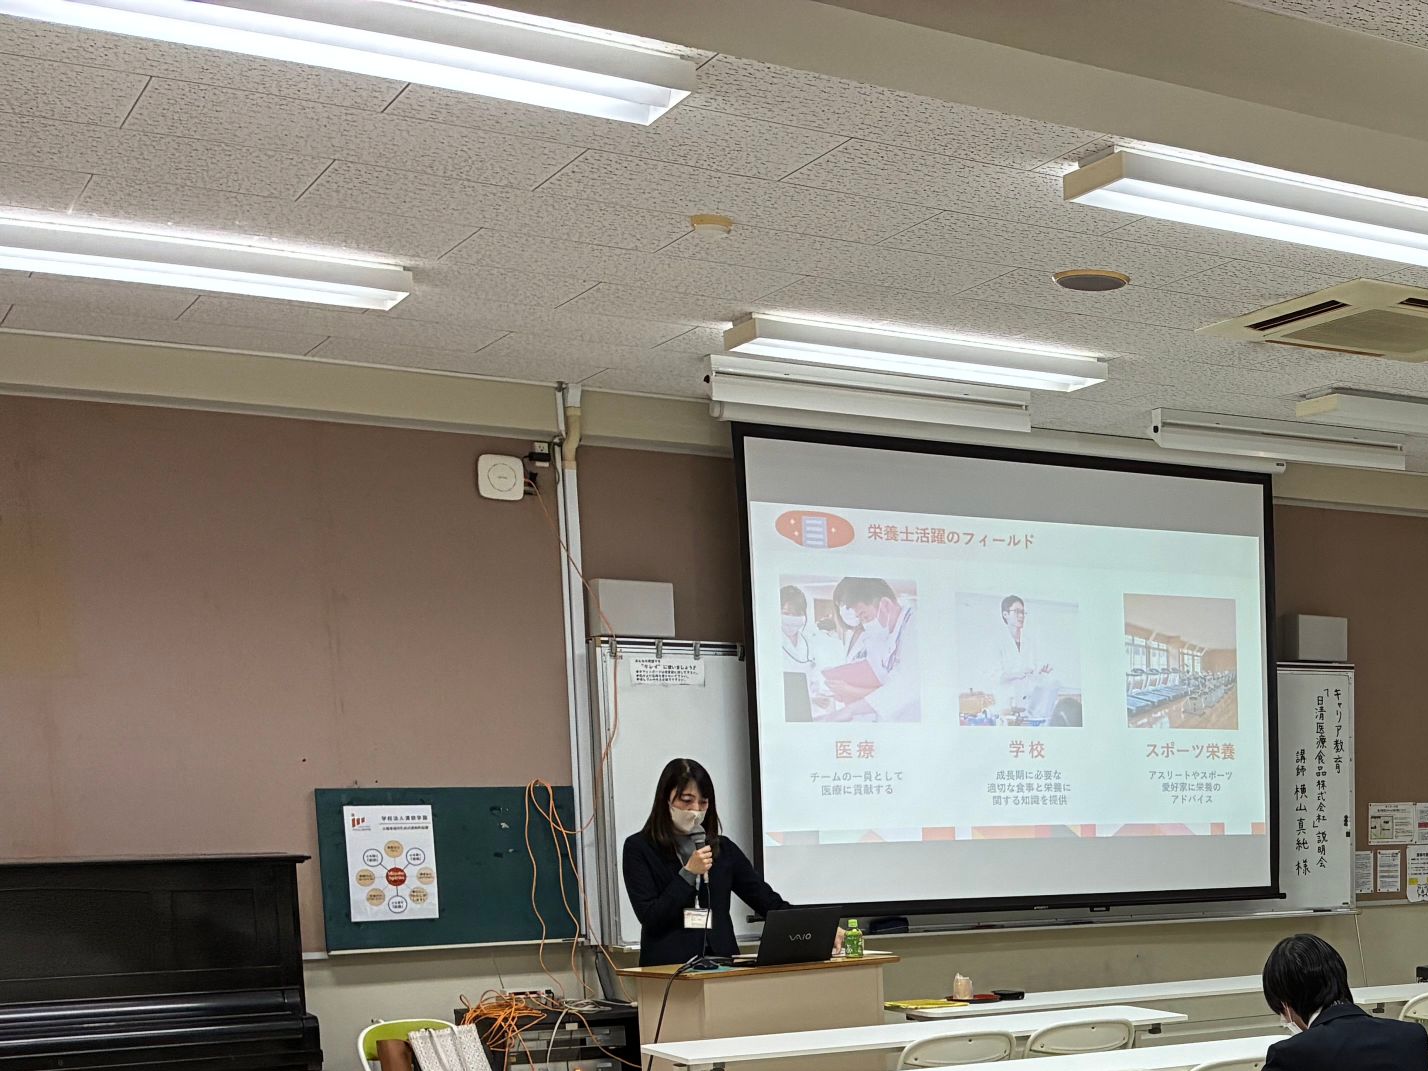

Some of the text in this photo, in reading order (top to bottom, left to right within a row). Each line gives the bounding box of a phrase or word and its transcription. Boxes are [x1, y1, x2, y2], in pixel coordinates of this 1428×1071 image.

[867, 523, 1035, 549] 栄養士活躍のフィールド
[1333, 688, 1345, 774] キャリア教育
[835, 740, 876, 759] 医療
[1009, 741, 1046, 759] 学校
[1146, 741, 1236, 760] スポーツ栄養
[810, 770, 903, 783] チームの一員として
[996, 769, 1062, 780] 成長期に必要な
[1148, 770, 1233, 781] アスリートやスポーツ
[821, 784, 893, 796] 医療に貢献する
[987, 782, 1071, 793] 適切な食事と栄養に
[1162, 782, 1221, 792] 愛好家に栄養の
[992, 794, 1068, 806] 関する知識を提供
[1171, 794, 1214, 805] アドバイス
